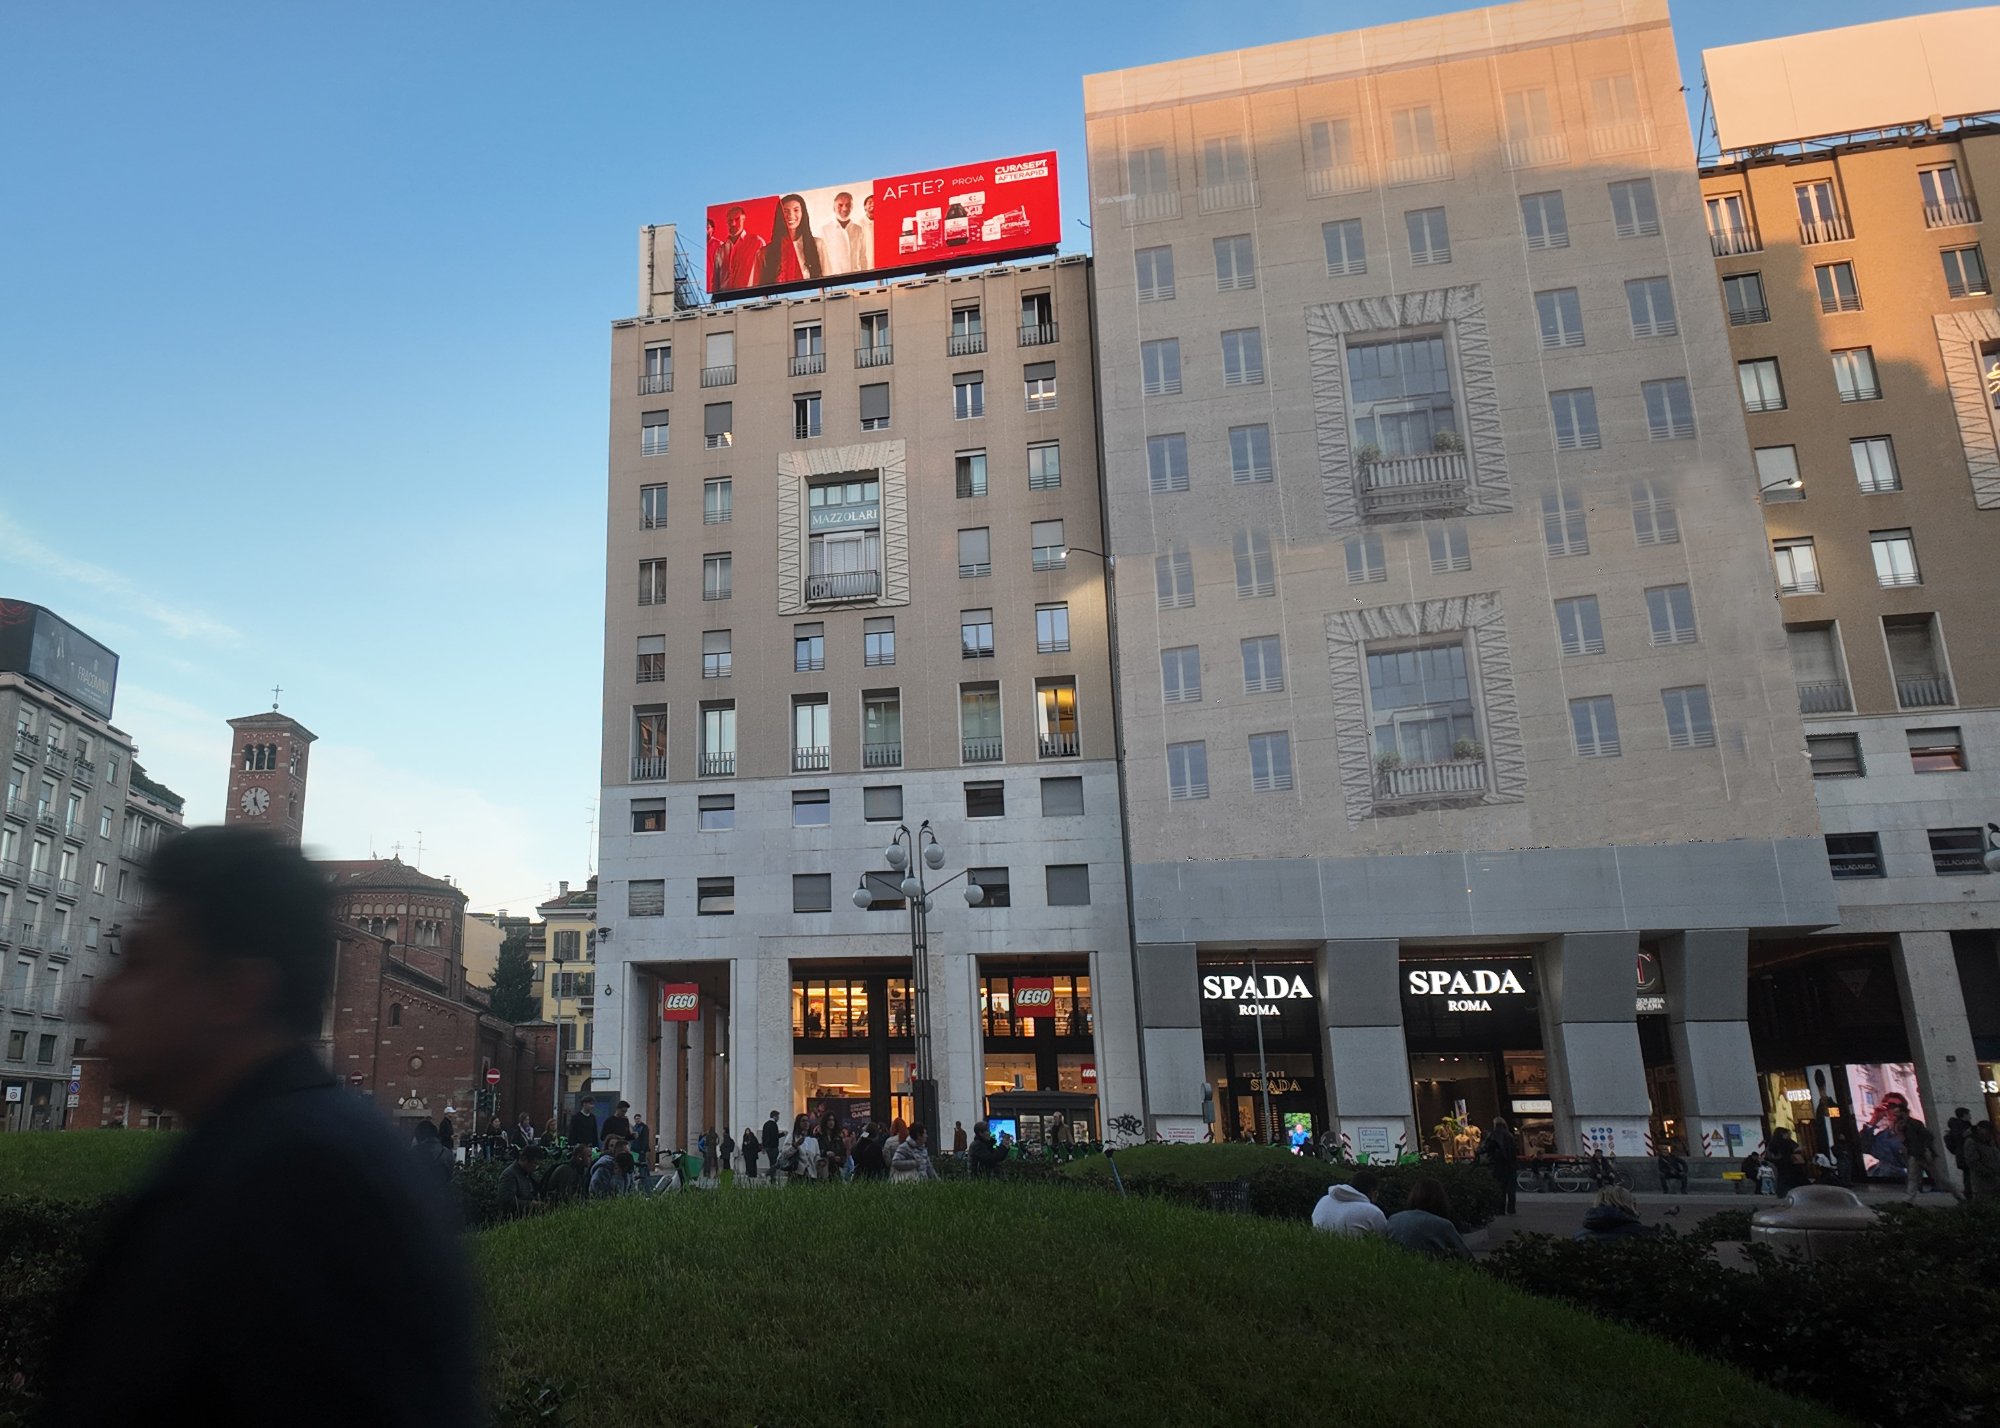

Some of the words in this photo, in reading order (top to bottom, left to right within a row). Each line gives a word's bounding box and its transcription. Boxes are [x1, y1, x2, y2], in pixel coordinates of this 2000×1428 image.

[995, 159, 1048, 174] CURASEPT
[997, 169, 1045, 181] AFTERAPID
[883, 179, 945, 201] AFTE?
[952, 175, 985, 187] PROVA
[812, 509, 878, 526] MAZZOLARI
[1203, 975, 1313, 999] SPADA
[1409, 969, 1526, 995] SPADA
[666, 994, 697, 1009] LEGO
[1017, 989, 1052, 1005] LEGO
[1238, 1004, 1281, 1016] ROMA
[1448, 1000, 1492, 1011] ROMA
[1787, 1089, 1812, 1101] GUESS
